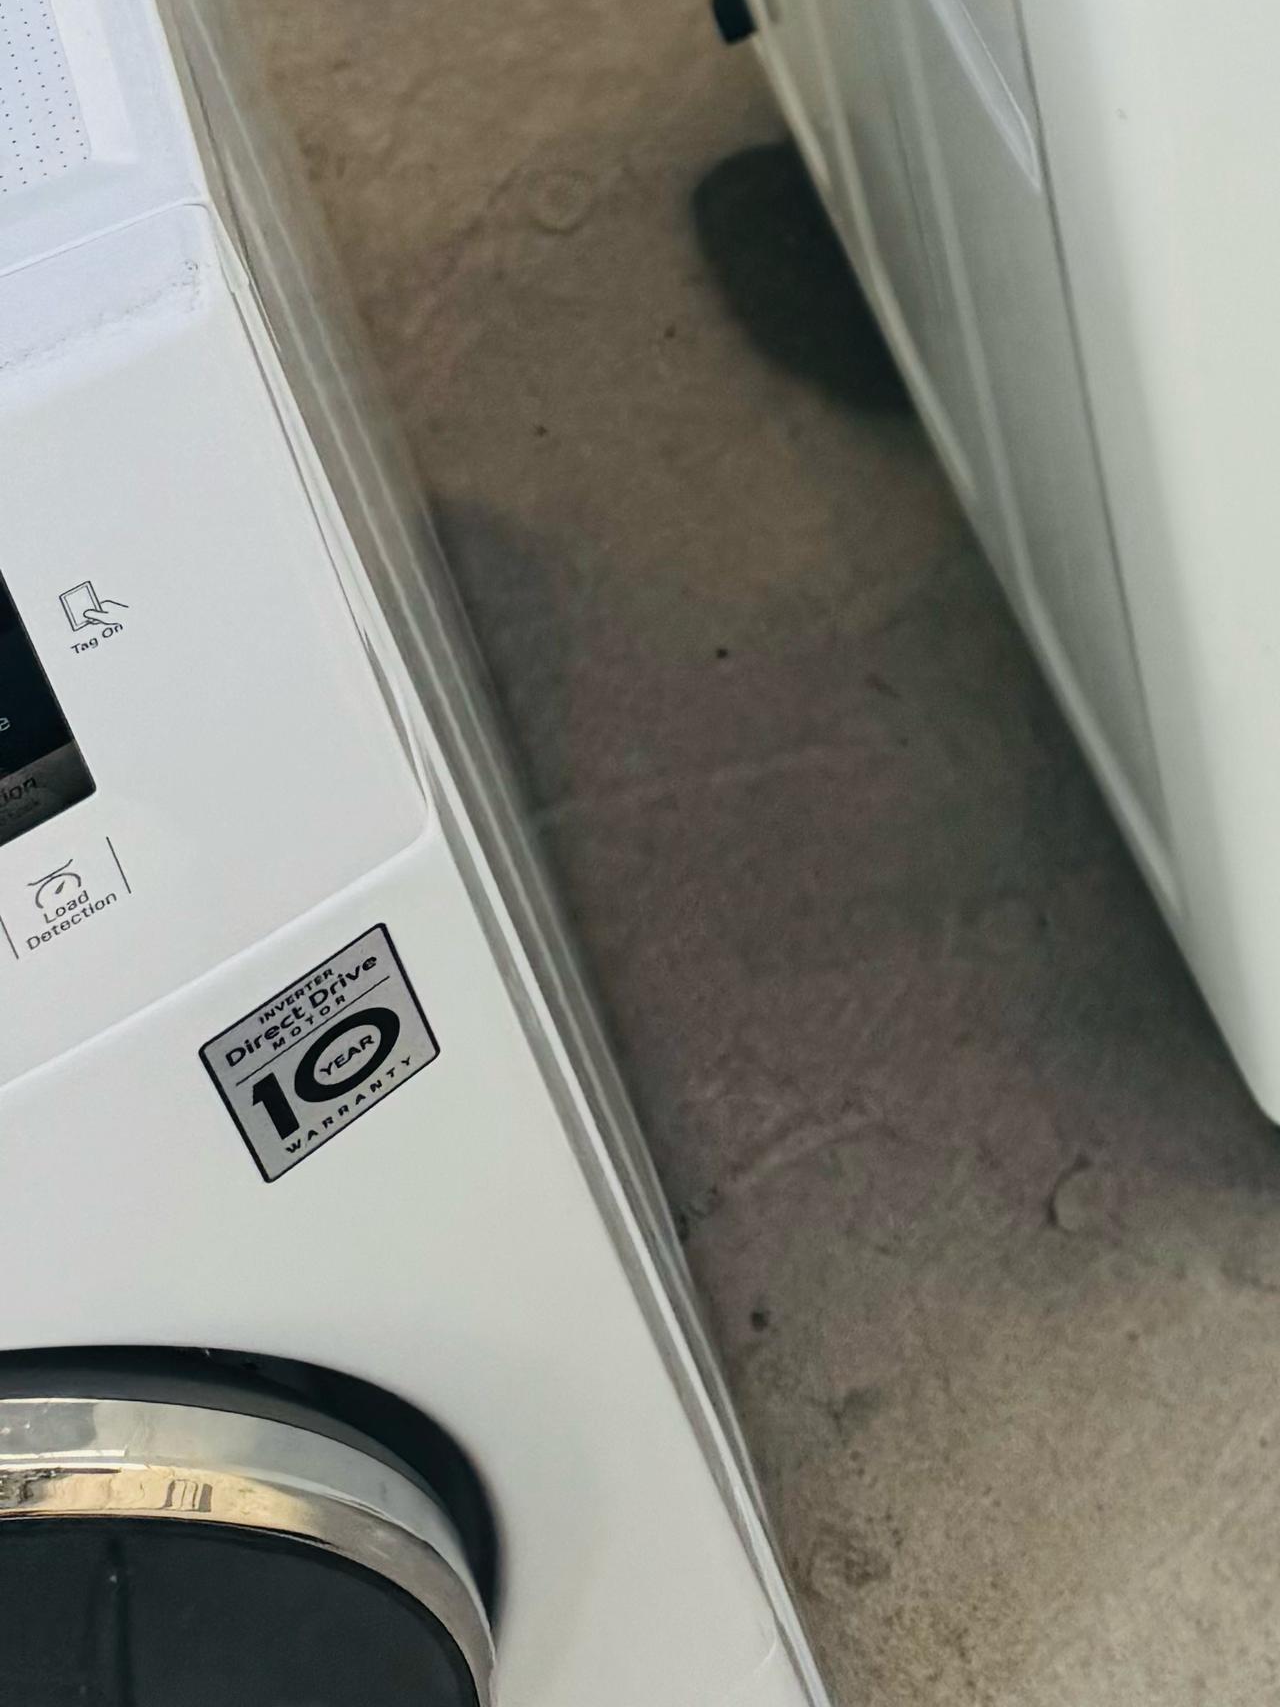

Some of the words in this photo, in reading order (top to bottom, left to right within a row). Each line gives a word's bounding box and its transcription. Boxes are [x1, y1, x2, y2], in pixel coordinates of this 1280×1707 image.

[70, 636, 99, 655] Tag
[102, 623, 124, 639] On
[26, 892, 118, 951] Detection
[43, 890, 90, 924] Load
[225, 1003, 308, 1067] Direct
[308, 956, 378, 1008] Drive
[258, 968, 335, 1025] INVERTER
[272, 994, 346, 1051] MOTOR
[252, 1007, 401, 1140] 10
[319, 1034, 375, 1076] YEAR
[285, 1054, 411, 1154] WARRANTY
